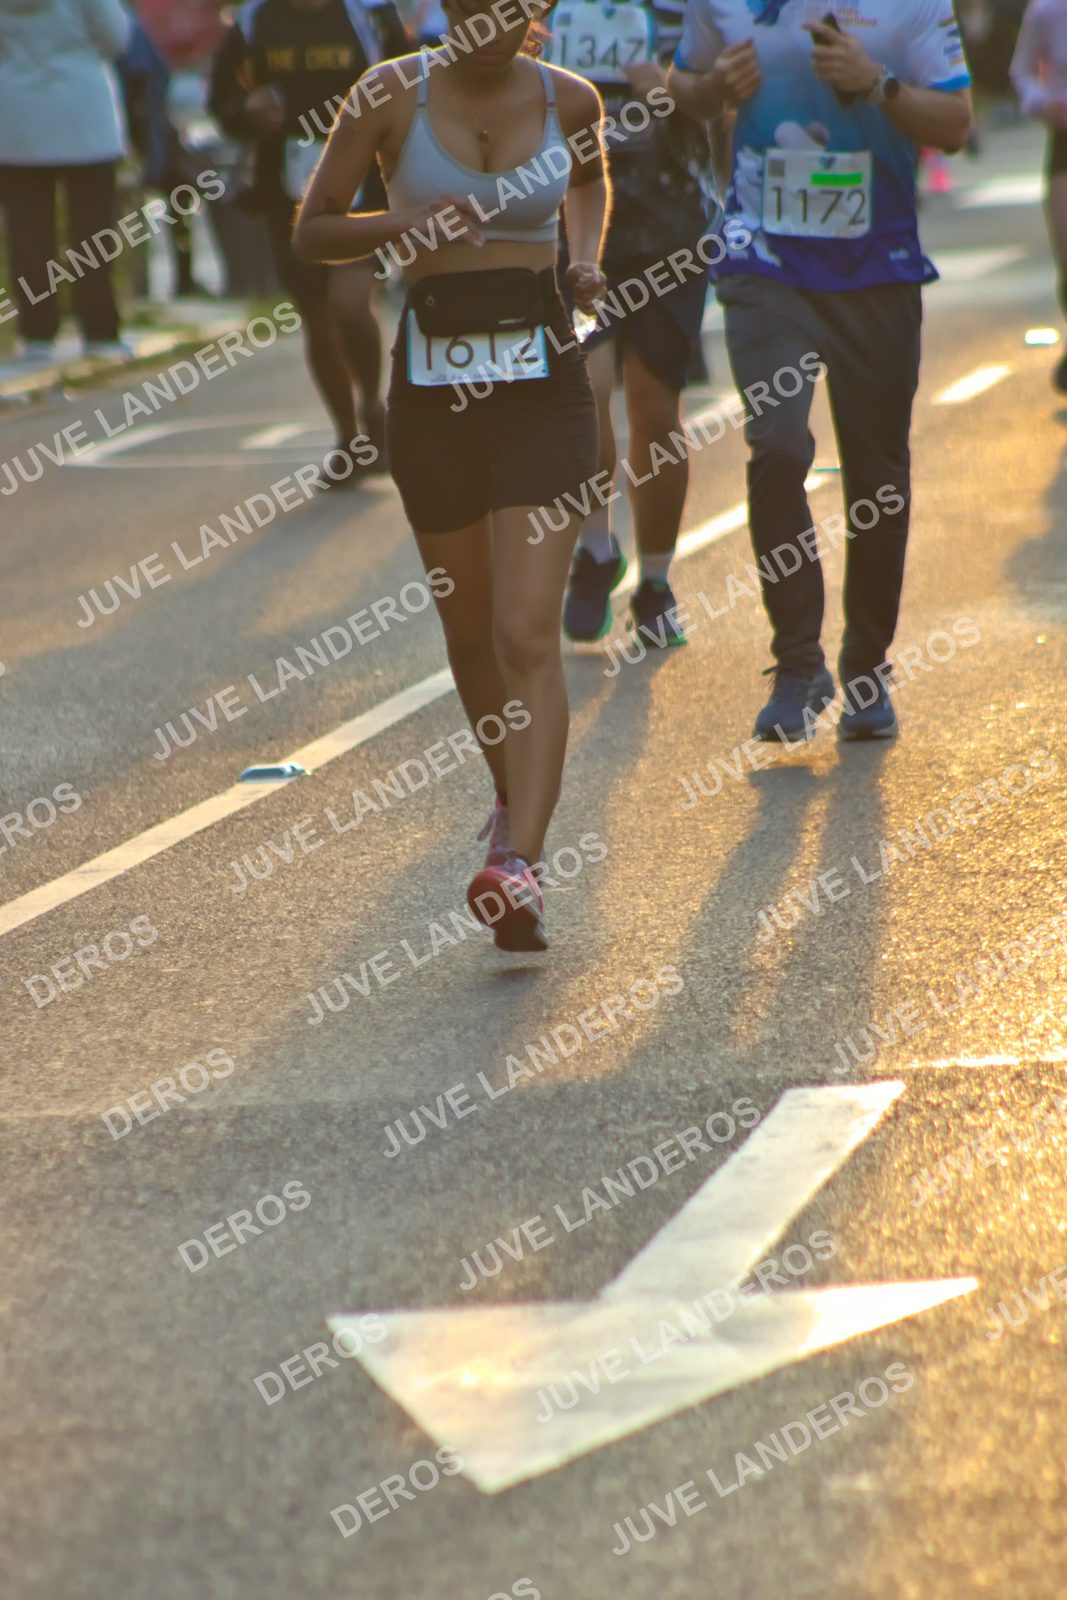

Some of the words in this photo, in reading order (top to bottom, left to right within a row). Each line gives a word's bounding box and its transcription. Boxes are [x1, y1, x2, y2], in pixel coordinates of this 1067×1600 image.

[560, 33, 645, 69] 1347
[771, 186, 866, 226] 1172
[424, 327, 541, 371] 1612
